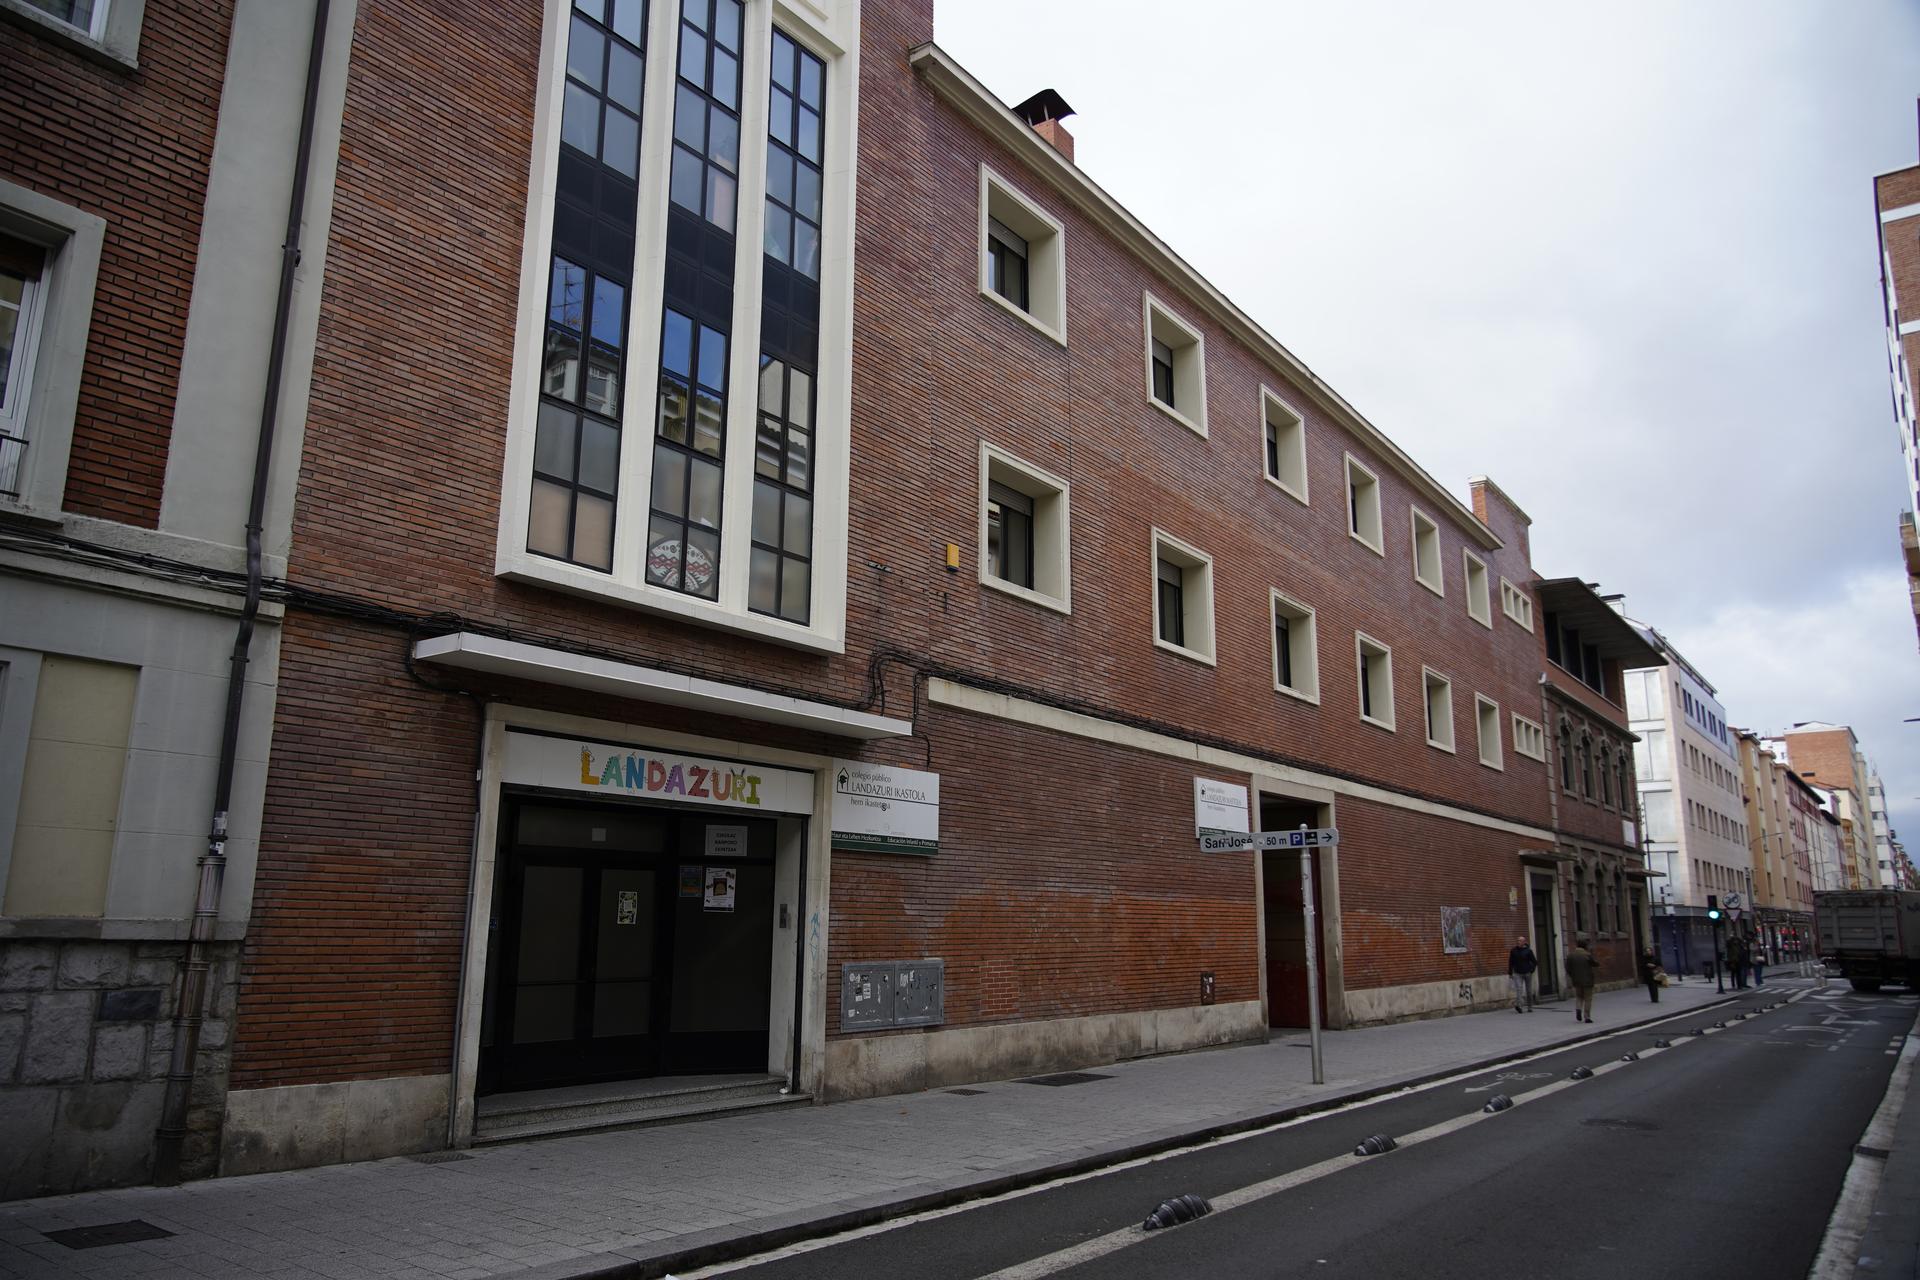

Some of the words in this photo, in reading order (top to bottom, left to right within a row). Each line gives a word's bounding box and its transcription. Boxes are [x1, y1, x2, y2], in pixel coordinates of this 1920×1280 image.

[580, 749, 761, 804] LANDAZURI
[851, 771, 872, 782] colegio
[852, 783, 893, 796] LANDAZURI
[894, 787, 926, 801] IKASTOLA
[1205, 837, 1225, 849] San
[1266, 836, 1277, 846] 50
[1278, 837, 1287, 845] m
[1292, 834, 1301, 845] P
